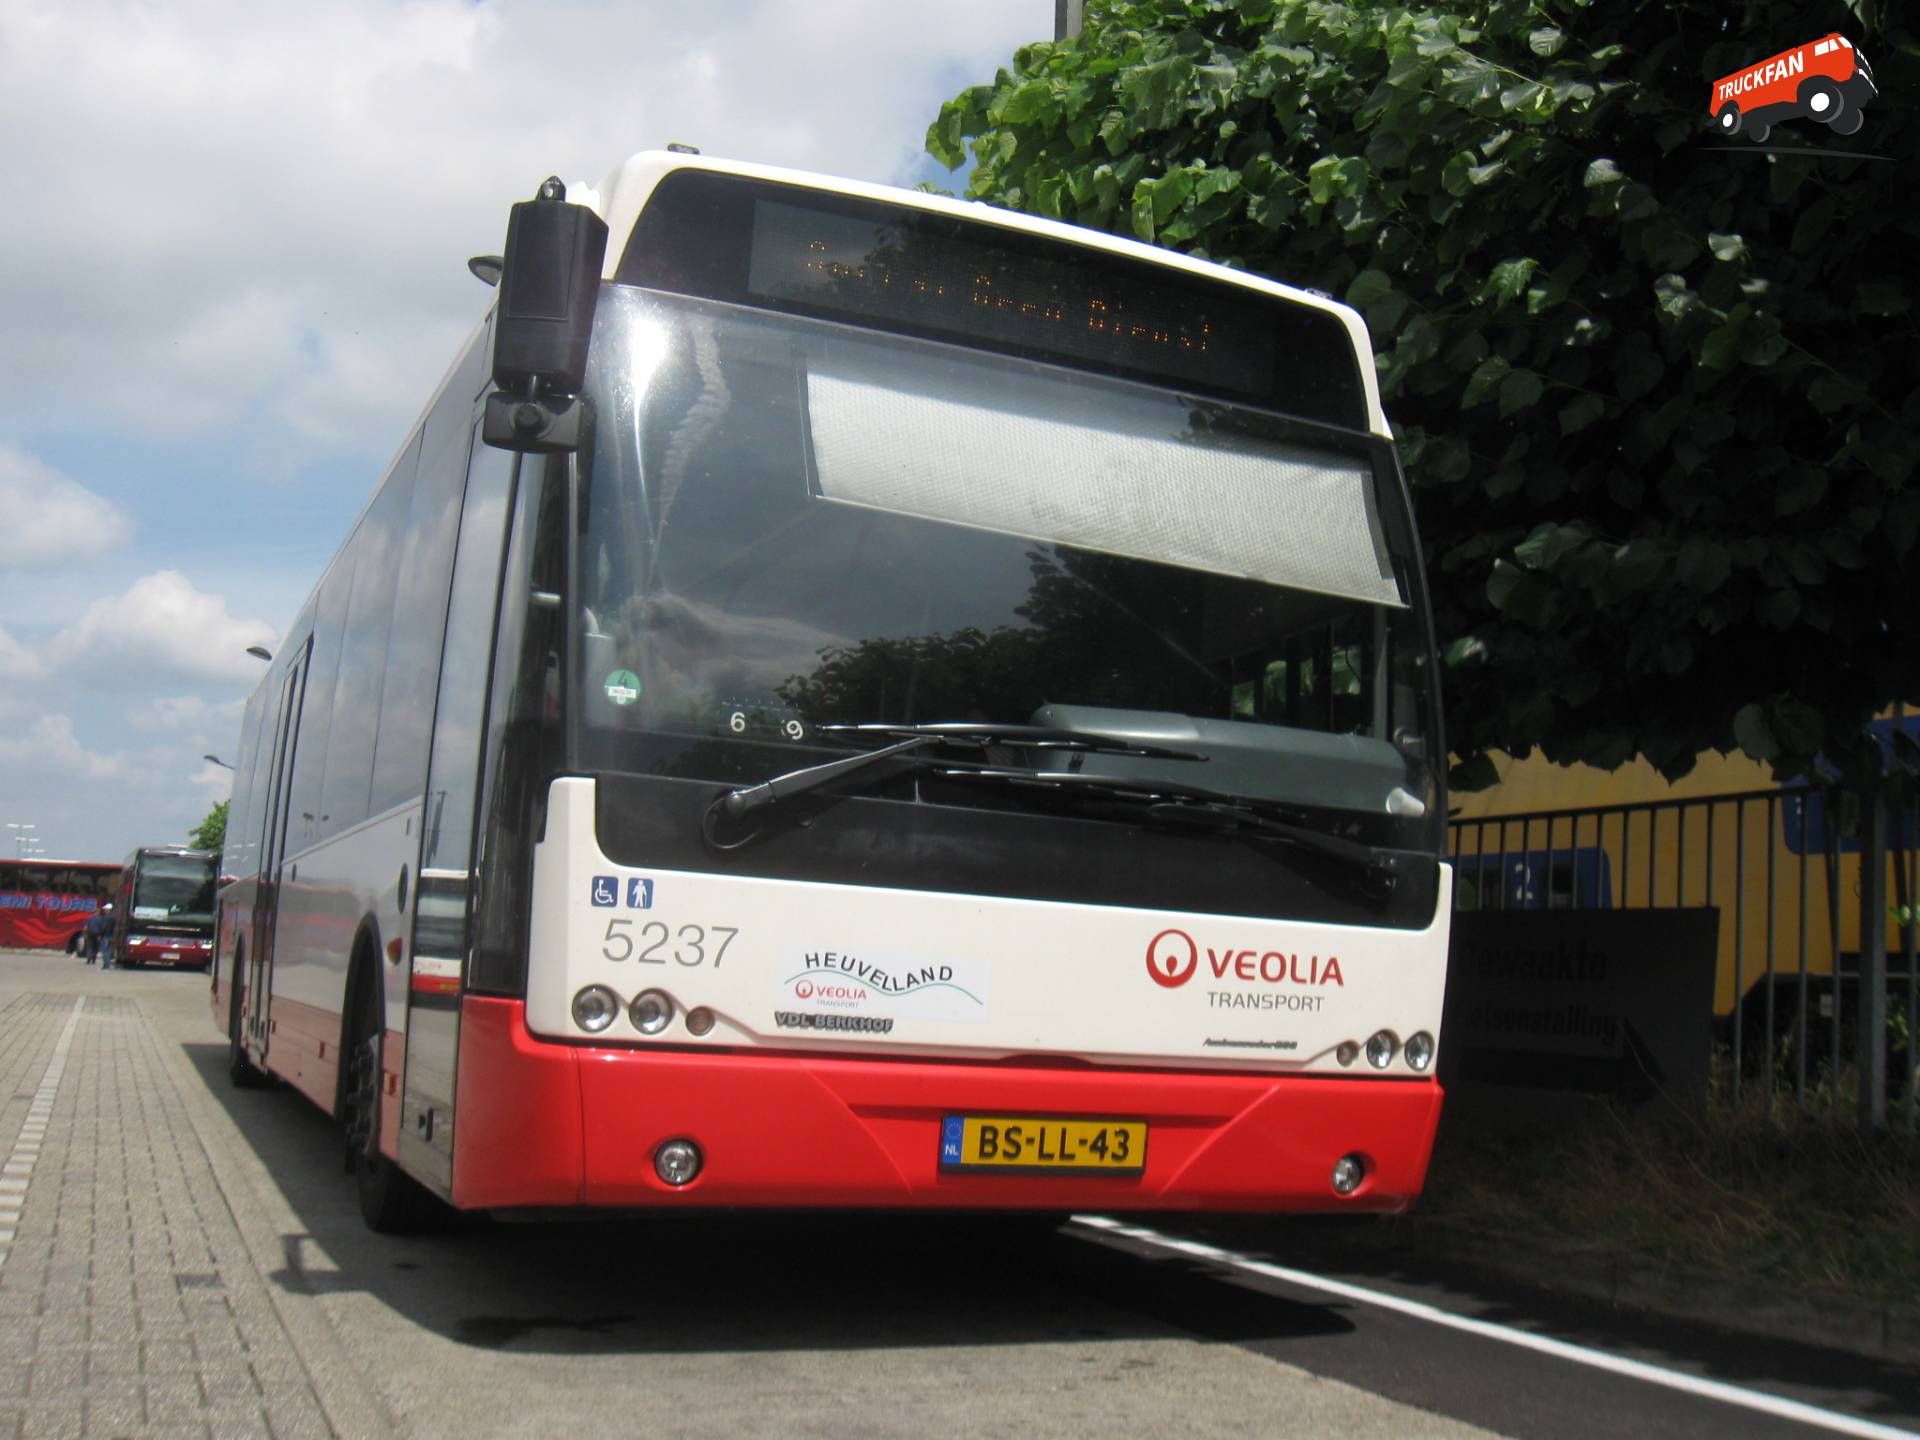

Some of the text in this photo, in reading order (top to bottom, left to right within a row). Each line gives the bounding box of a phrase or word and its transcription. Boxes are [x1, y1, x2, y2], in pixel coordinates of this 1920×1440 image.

[730, 711, 746, 732] 6
[602, 918, 739, 969] 5237
[804, 951, 953, 992] HEUVELLAND
[1207, 948, 1345, 987] VEOLIA
[816, 985, 867, 1000] VEOLIA
[1207, 991, 1326, 1013] TRANSPORT
[774, 1010, 894, 1034] VDL BERKHOF
[945, 1144, 959, 1156] NL
[978, 1125, 1130, 1162] BS-LL-43
